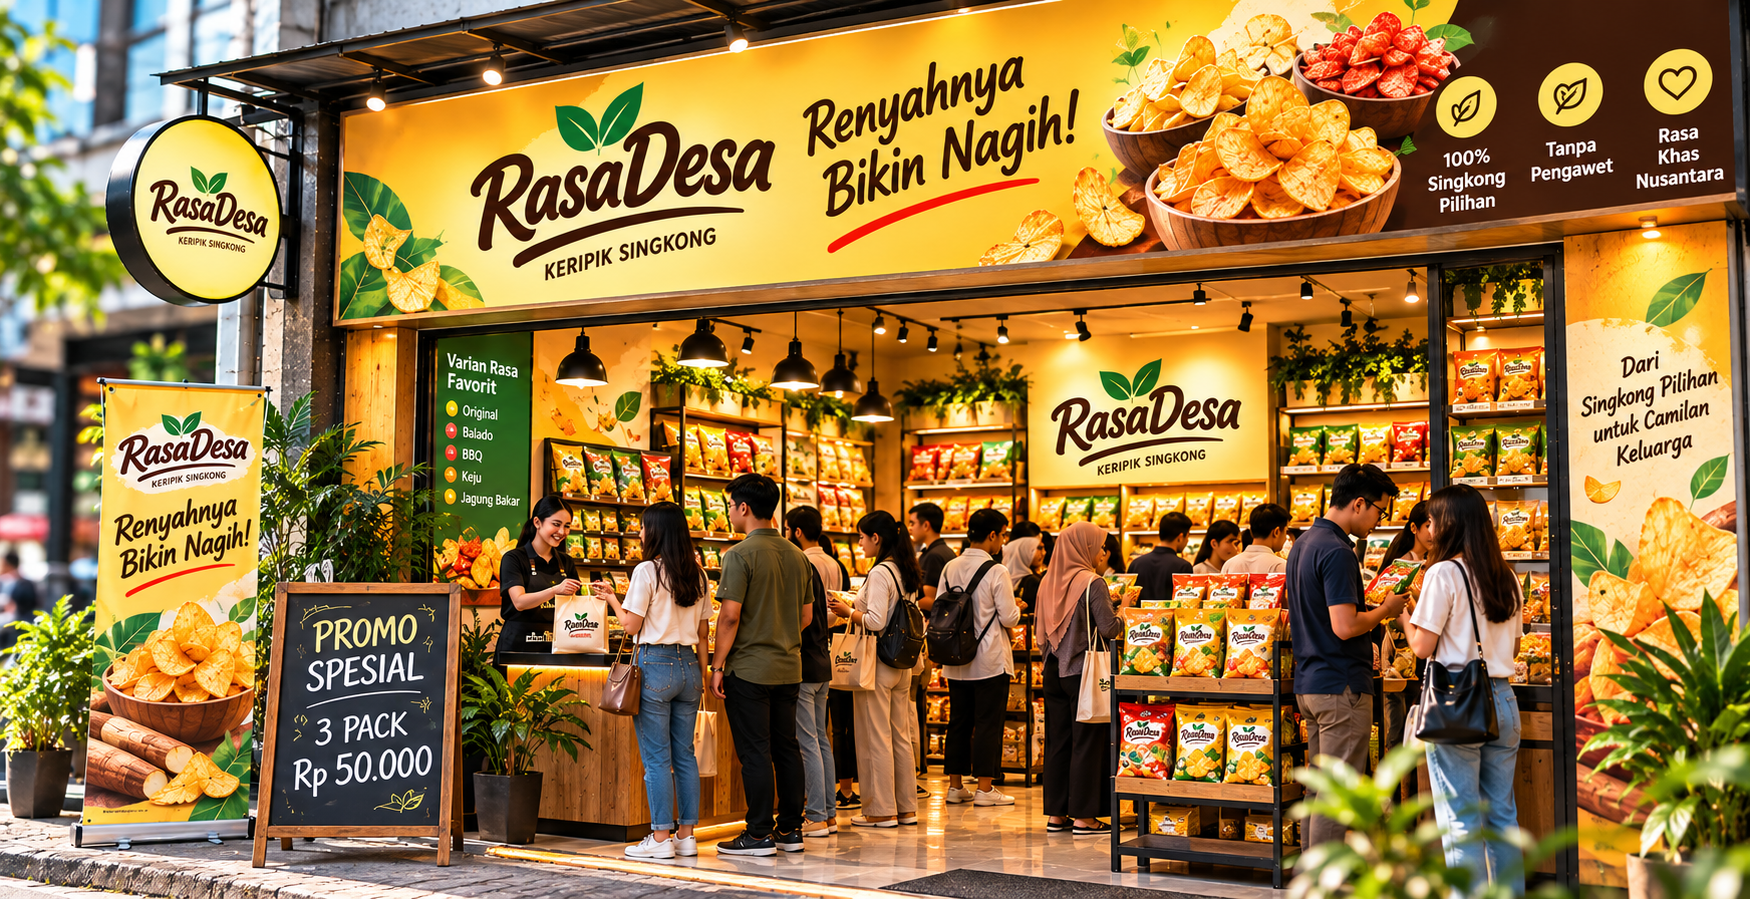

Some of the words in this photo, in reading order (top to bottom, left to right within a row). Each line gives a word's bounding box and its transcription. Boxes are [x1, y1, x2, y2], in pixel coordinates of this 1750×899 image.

[803, 55, 1025, 156] Renyahnya
[1545, 139, 1598, 159] Tanpa
[1658, 127, 1700, 144] Rasa
[823, 148, 925, 217] Bikin
[941, 89, 1080, 178] Nagih!
[1443, 149, 1491, 168] 100%
[1658, 148, 1700, 165] Khas
[1428, 170, 1507, 192] Singkong
[1531, 159, 1614, 182] Pengawet
[1636, 166, 1724, 188] Nusantara
[470, 121, 776, 252] RasaDesa
[150, 179, 269, 239] RasaDesa
[1439, 193, 1497, 214] Pilihan
[177, 235, 208, 248] KERIPIK
[208, 239, 247, 254] SINGKONG
[544, 247, 613, 281] KERIPIK
[619, 227, 718, 262] SINGKONG
[446, 352, 487, 374] Varian
[489, 360, 519, 379] Rasa
[1620, 350, 1660, 380] Dari
[447, 373, 497, 395] Favorit
[1580, 379, 1656, 418] Singkong
[1659, 368, 1720, 400] Pilihan
[462, 404, 499, 421] Original
[1051, 384, 1242, 456] RasaDesa
[1593, 414, 1640, 444] untuk
[1643, 399, 1711, 430] Camilan
[462, 426, 494, 442] Balado
[118, 429, 250, 476] RasaDesa
[462, 448, 484, 464] BBQ
[1097, 457, 1141, 476] KERIPIK
[1144, 449, 1207, 468] SINGKONG
[1615, 433, 1694, 468] Keluarga
[151, 476, 184, 489] KERIPIK
[185, 470, 227, 484] SINGKONG
[461, 470, 482, 485] Keju
[460, 492, 494, 508] Jagung
[495, 493, 521, 507] Bakar
[114, 498, 238, 546] Renyahnya
[120, 545, 177, 580] Bikin
[184, 519, 252, 562] Nagih!
[313, 614, 418, 653] PROMO
[306, 652, 424, 692] SPESIAL
[314, 717, 332, 747] 3
[343, 711, 408, 743] PACK
[293, 758, 328, 797] Rp
[335, 745, 433, 786] 50.000
